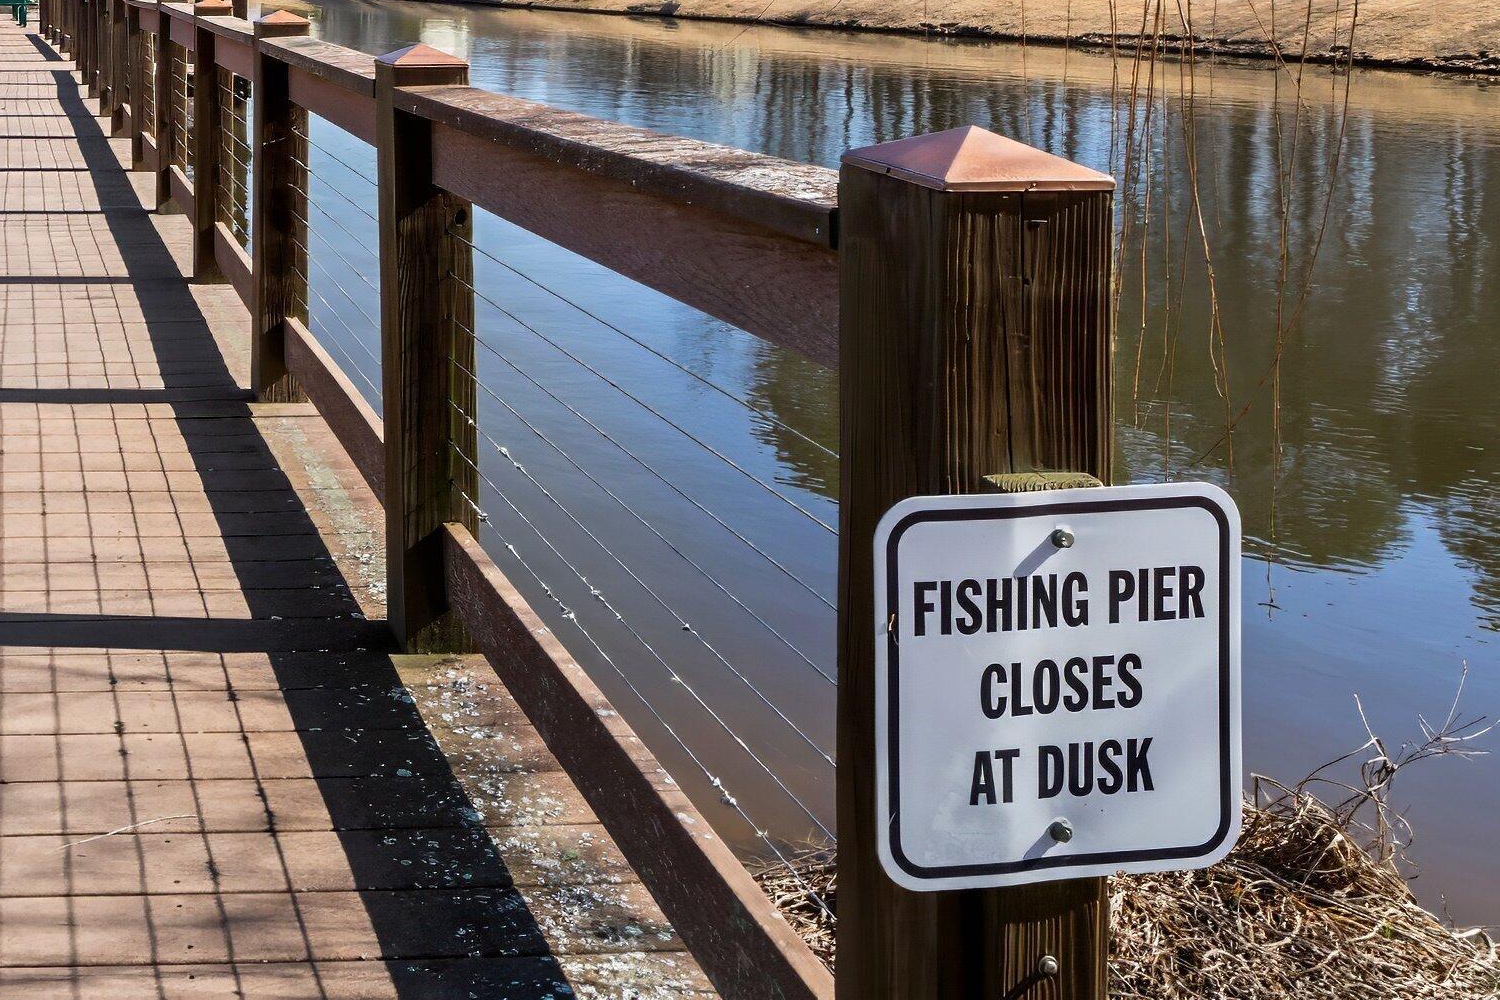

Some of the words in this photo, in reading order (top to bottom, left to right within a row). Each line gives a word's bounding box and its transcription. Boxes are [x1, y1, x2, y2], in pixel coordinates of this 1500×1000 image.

[913, 571, 1089, 637] FISHING
[1108, 565, 1206, 624] PIER
[980, 653, 1143, 720] CLOSES
[969, 748, 1021, 806] AT
[1037, 736, 1155, 800] DUSK
